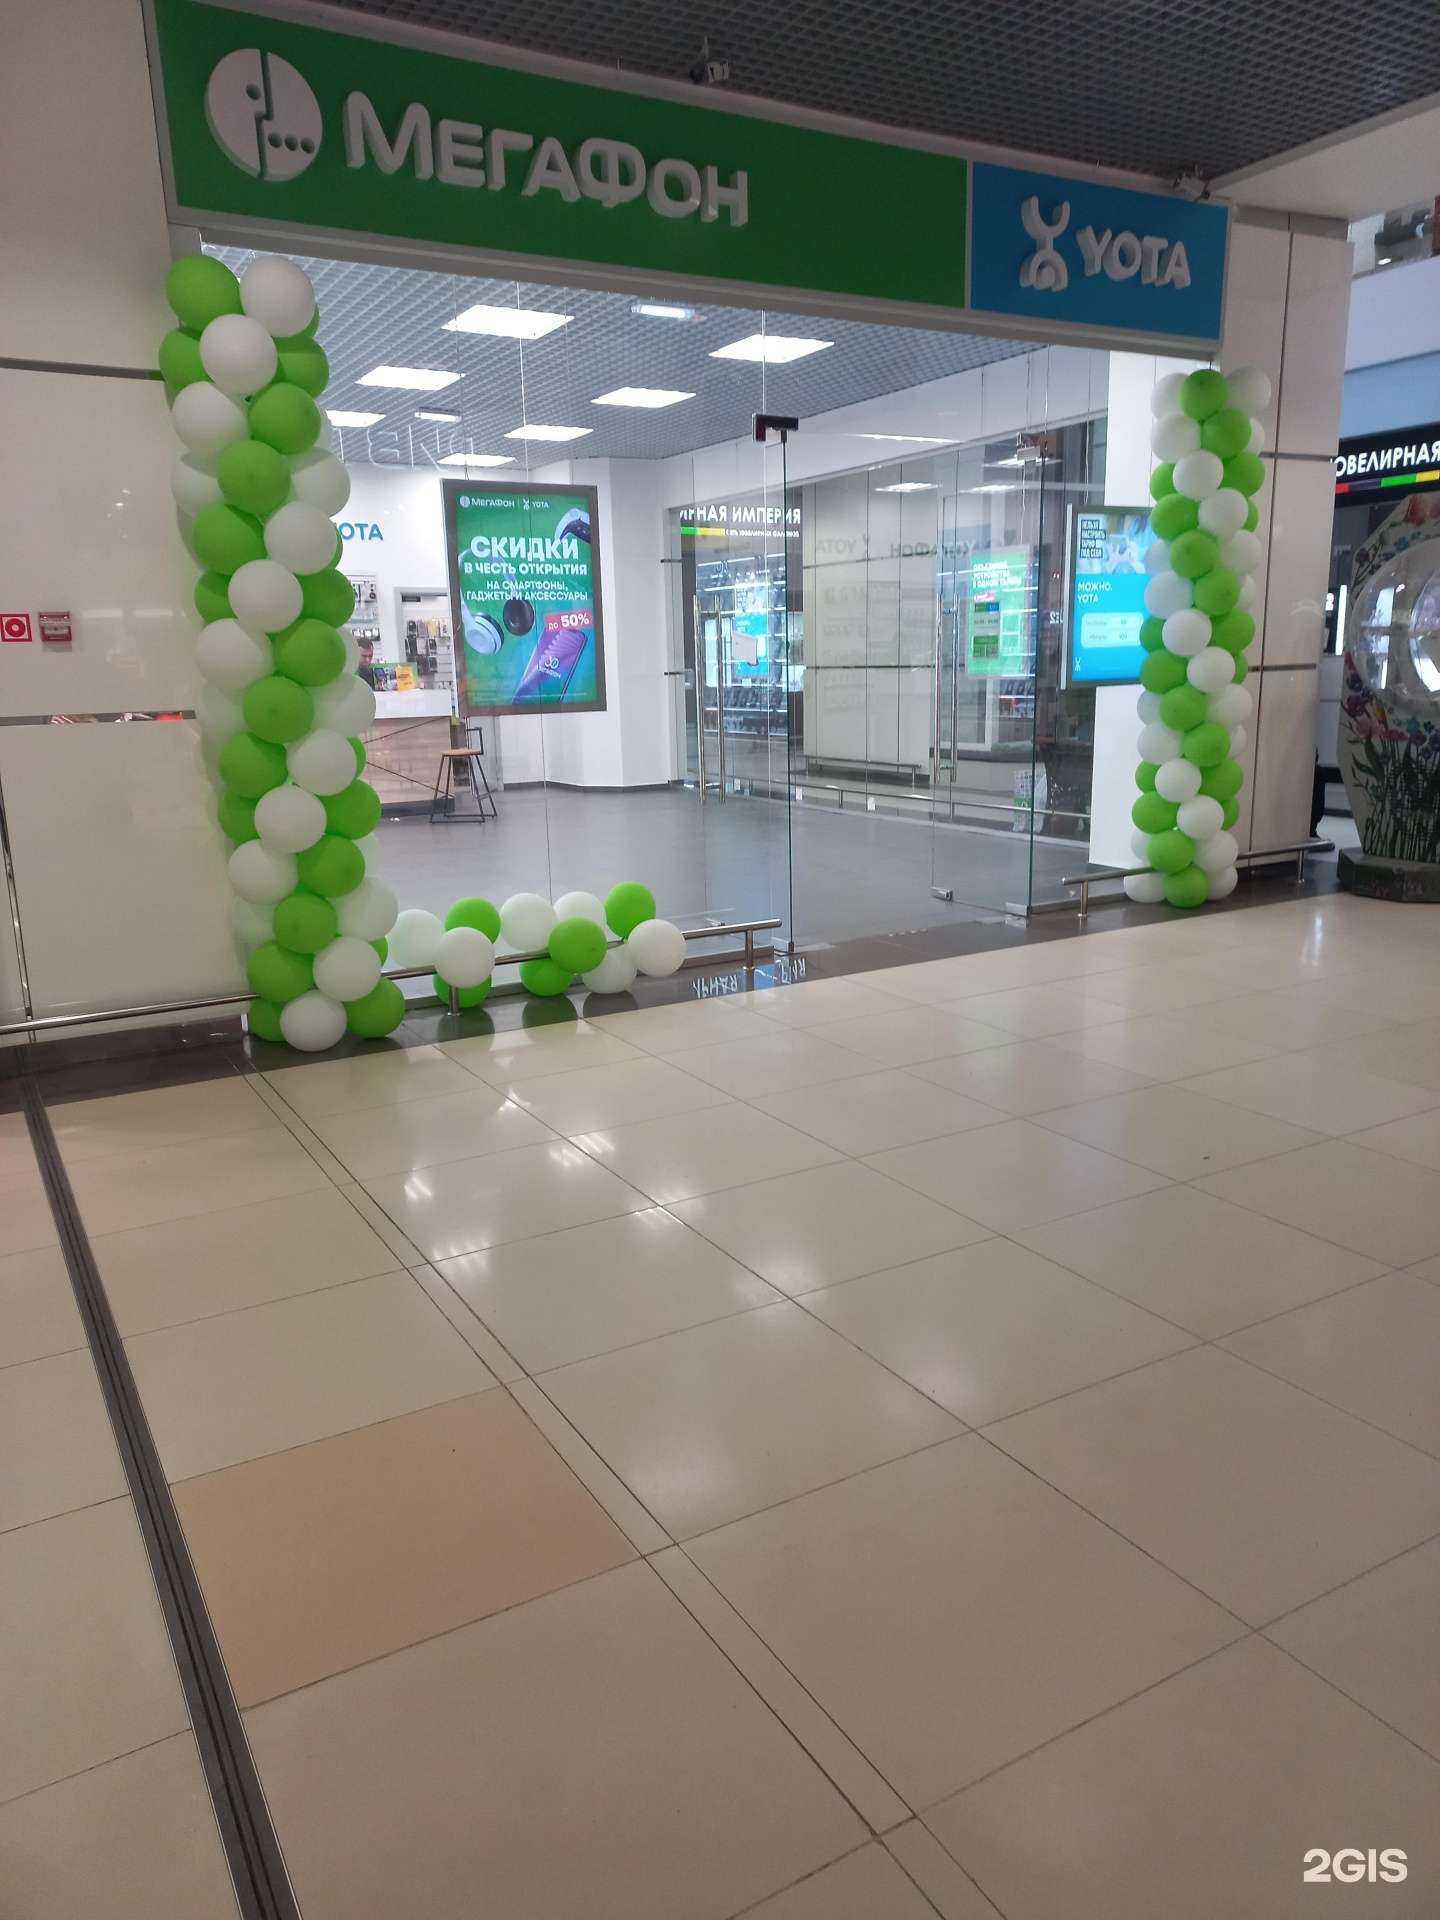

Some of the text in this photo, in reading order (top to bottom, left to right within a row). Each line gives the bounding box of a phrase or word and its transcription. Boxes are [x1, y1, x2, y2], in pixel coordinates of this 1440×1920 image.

[1076, 225, 1191, 289] YOTA
[532, 501, 549, 509] YOTA
[680, 504, 800, 524] ИРНАЯ ИМПЕРИЯ
[338, 522, 384, 541] OTA
[470, 535, 579, 562] СКИДКИ
[464, 563, 588, 575] В ЧЕСТЬ ОТКРЫТИЯ
[487, 581, 499, 589] НА
[466, 591, 588, 601] ГАДЖЕТЫ И АКСЕССУАРЫ
[560, 612, 589, 627] 50%
